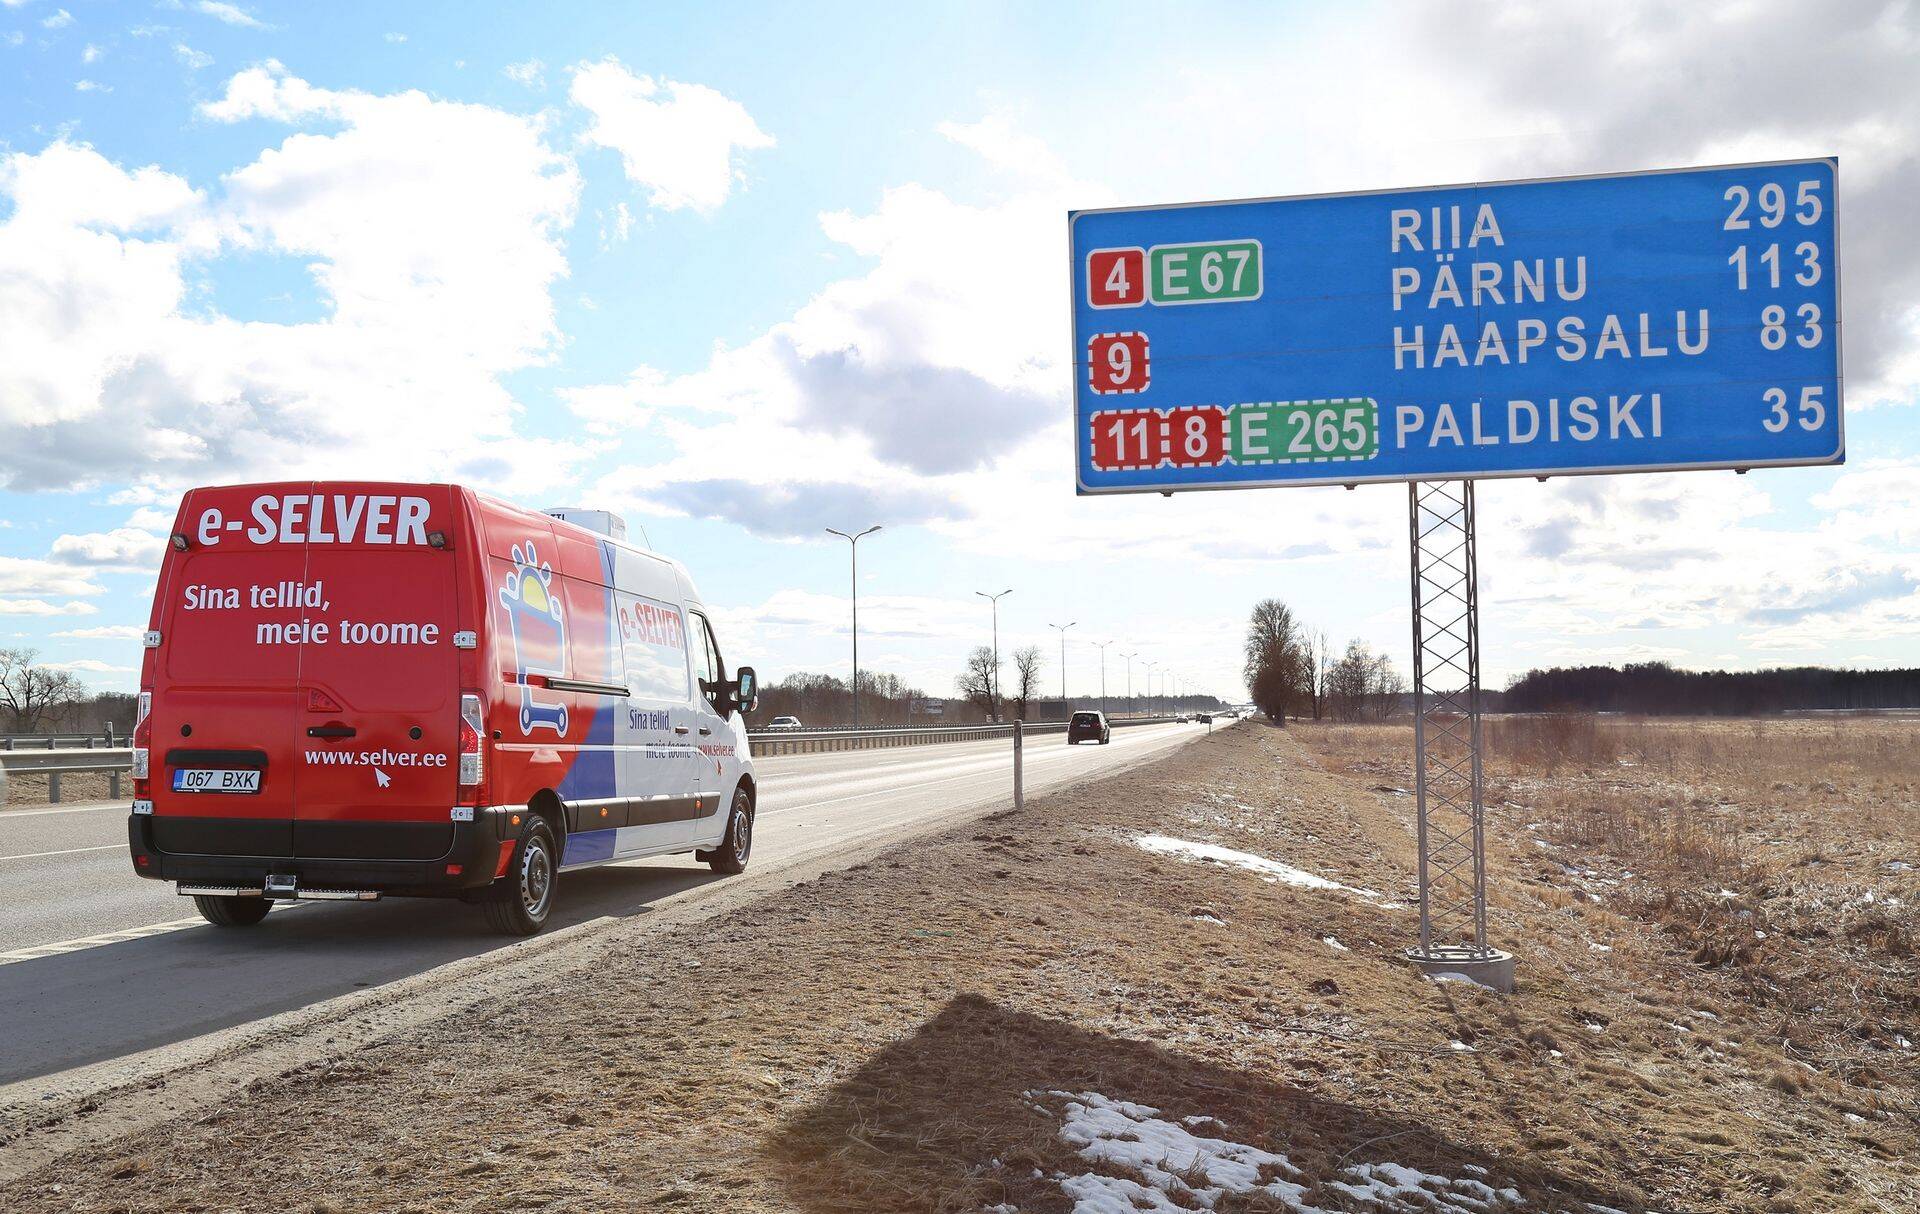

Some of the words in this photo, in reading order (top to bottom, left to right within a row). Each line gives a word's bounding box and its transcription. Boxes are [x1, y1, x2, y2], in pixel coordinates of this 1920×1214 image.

[1390, 203, 1505, 253] RIIA
[1722, 179, 1823, 231] 295
[1105, 257, 1131, 299] 4
[1162, 253, 1190, 296] E
[1200, 250, 1251, 294] 67
[1392, 253, 1588, 311] PÄRNU
[1727, 241, 1822, 290] 113
[1393, 309, 1709, 370] HAAPSALU
[1760, 302, 1823, 351] 83
[1107, 342, 1132, 385] 9
[1184, 415, 1208, 458] 8
[1241, 412, 1270, 455] E
[1287, 408, 1367, 453] 265
[1396, 393, 1662, 449] PALDISKI
[1762, 385, 1826, 434] 35
[1107, 418, 1149, 461] 11
[197, 494, 431, 547] e-SELVER
[183, 584, 241, 610] Sina
[250, 580, 330, 612] tellid,
[256, 619, 329, 645] meie
[339, 619, 440, 645] toome
[619, 601, 683, 649] e-SELVER
[629, 708, 648, 730] Sina
[649, 709, 672, 733] tellid,
[186, 771, 214, 787] 067
[222, 771, 256, 788] BXK
[305, 748, 448, 768] www.selver.ee
